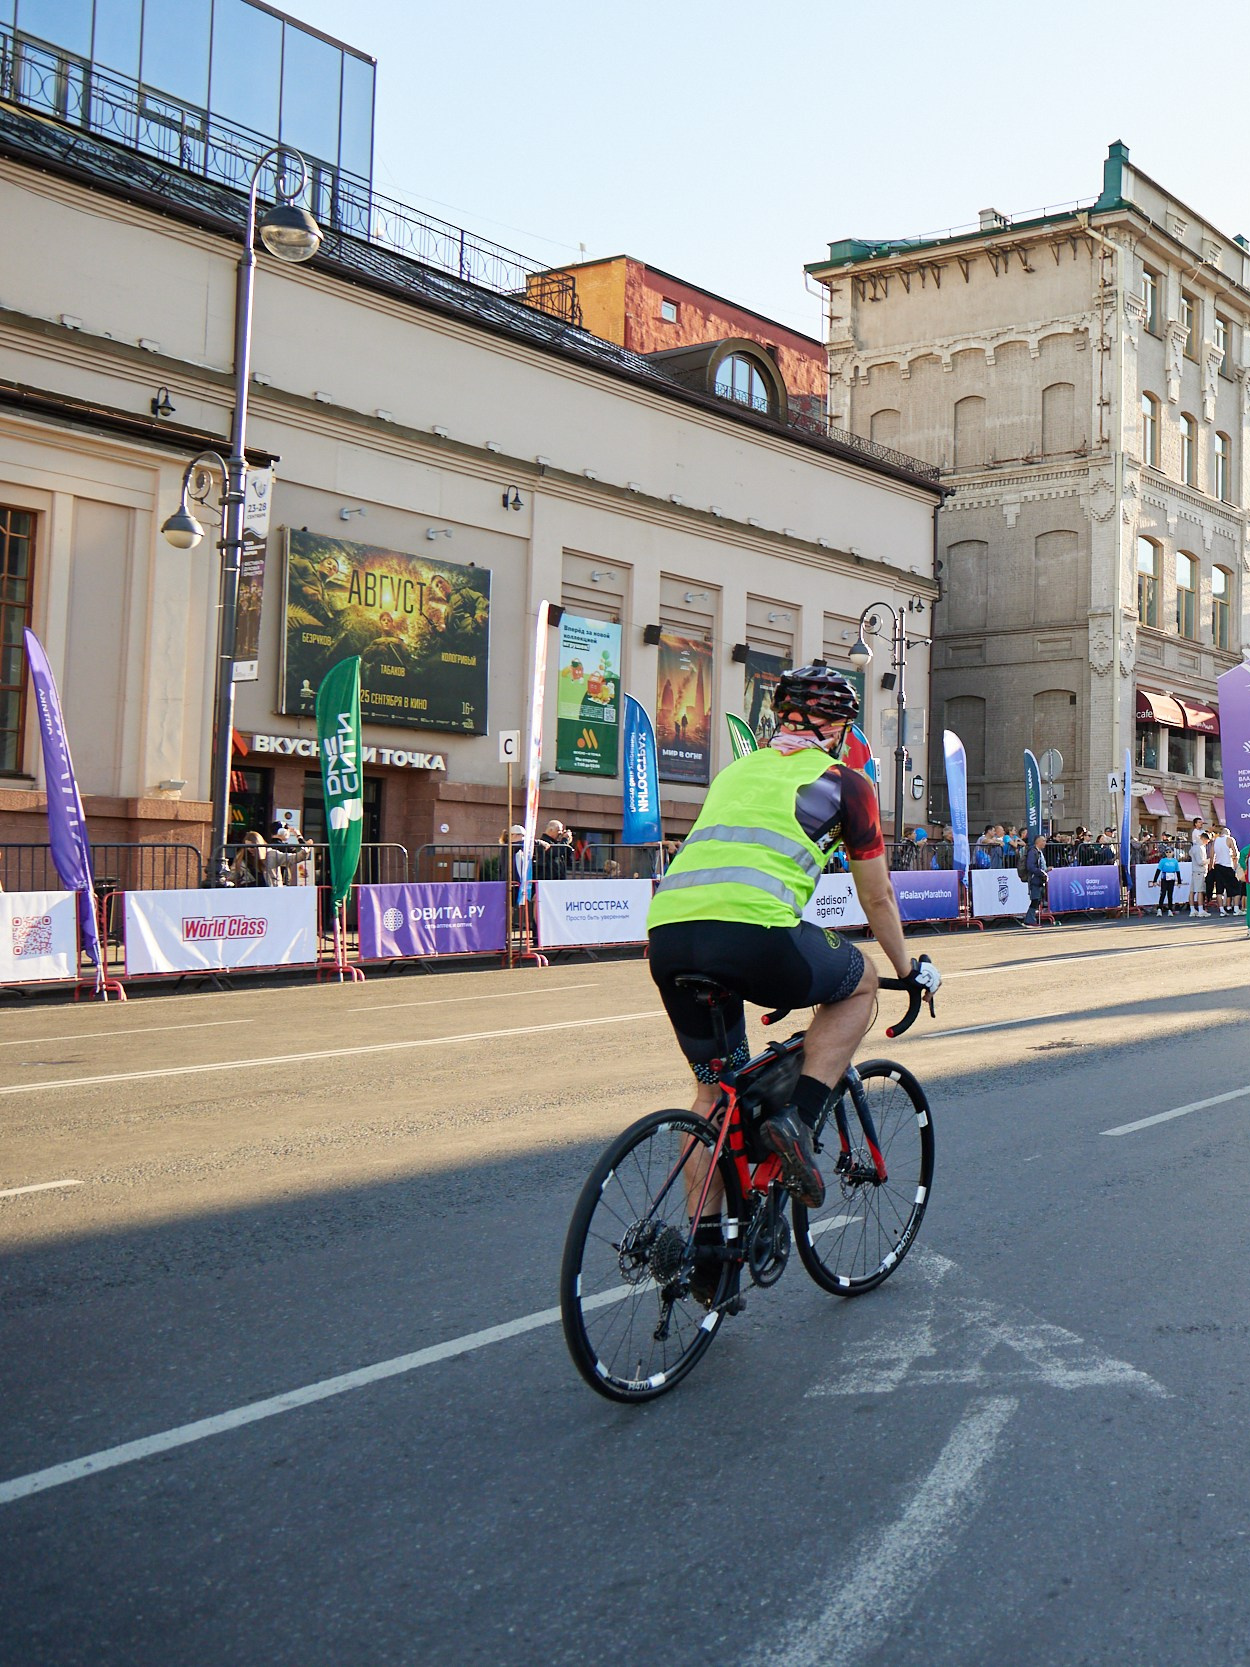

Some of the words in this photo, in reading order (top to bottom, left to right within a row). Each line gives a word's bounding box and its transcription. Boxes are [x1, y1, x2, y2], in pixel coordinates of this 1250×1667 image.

[248, 502, 267, 513] 23-28
[348, 570, 426, 616] АВГУСТ
[302, 632, 332, 646] БЕЗРУКОВ
[441, 652, 476, 666] КОЛОГРИВЫЙ
[381, 665, 405, 677] ТАБАКОВ
[360, 689, 370, 703] 25
[371, 692, 402, 707] СЕНТЯБРЯ
[404, 697, 408, 708] В
[410, 698, 428, 710] КИНО
[462, 702, 475, 715] 16+
[1136, 709, 1153, 719] cafe
[253, 735, 320, 757] ВКУСН
[362, 746, 376, 762] И
[379, 748, 446, 771] ТОЧКА
[337, 712, 359, 793] СИТИ
[504, 739, 512, 755] C
[662, 749, 678, 757] МИР
[685, 752, 702, 760] ОГНЕ
[816, 895, 847, 905] eddison
[900, 890, 952, 900] #GalaxyMarathon
[566, 900, 629, 911] ИНГОССТРАХ
[816, 906, 845, 918] agency
[410, 905, 486, 921] ОВИТА.РУ
[185, 919, 226, 938] World
[228, 918, 265, 936] Class
[895, 1230, 911, 1255] R470
[628, 1380, 650, 1391] R470
